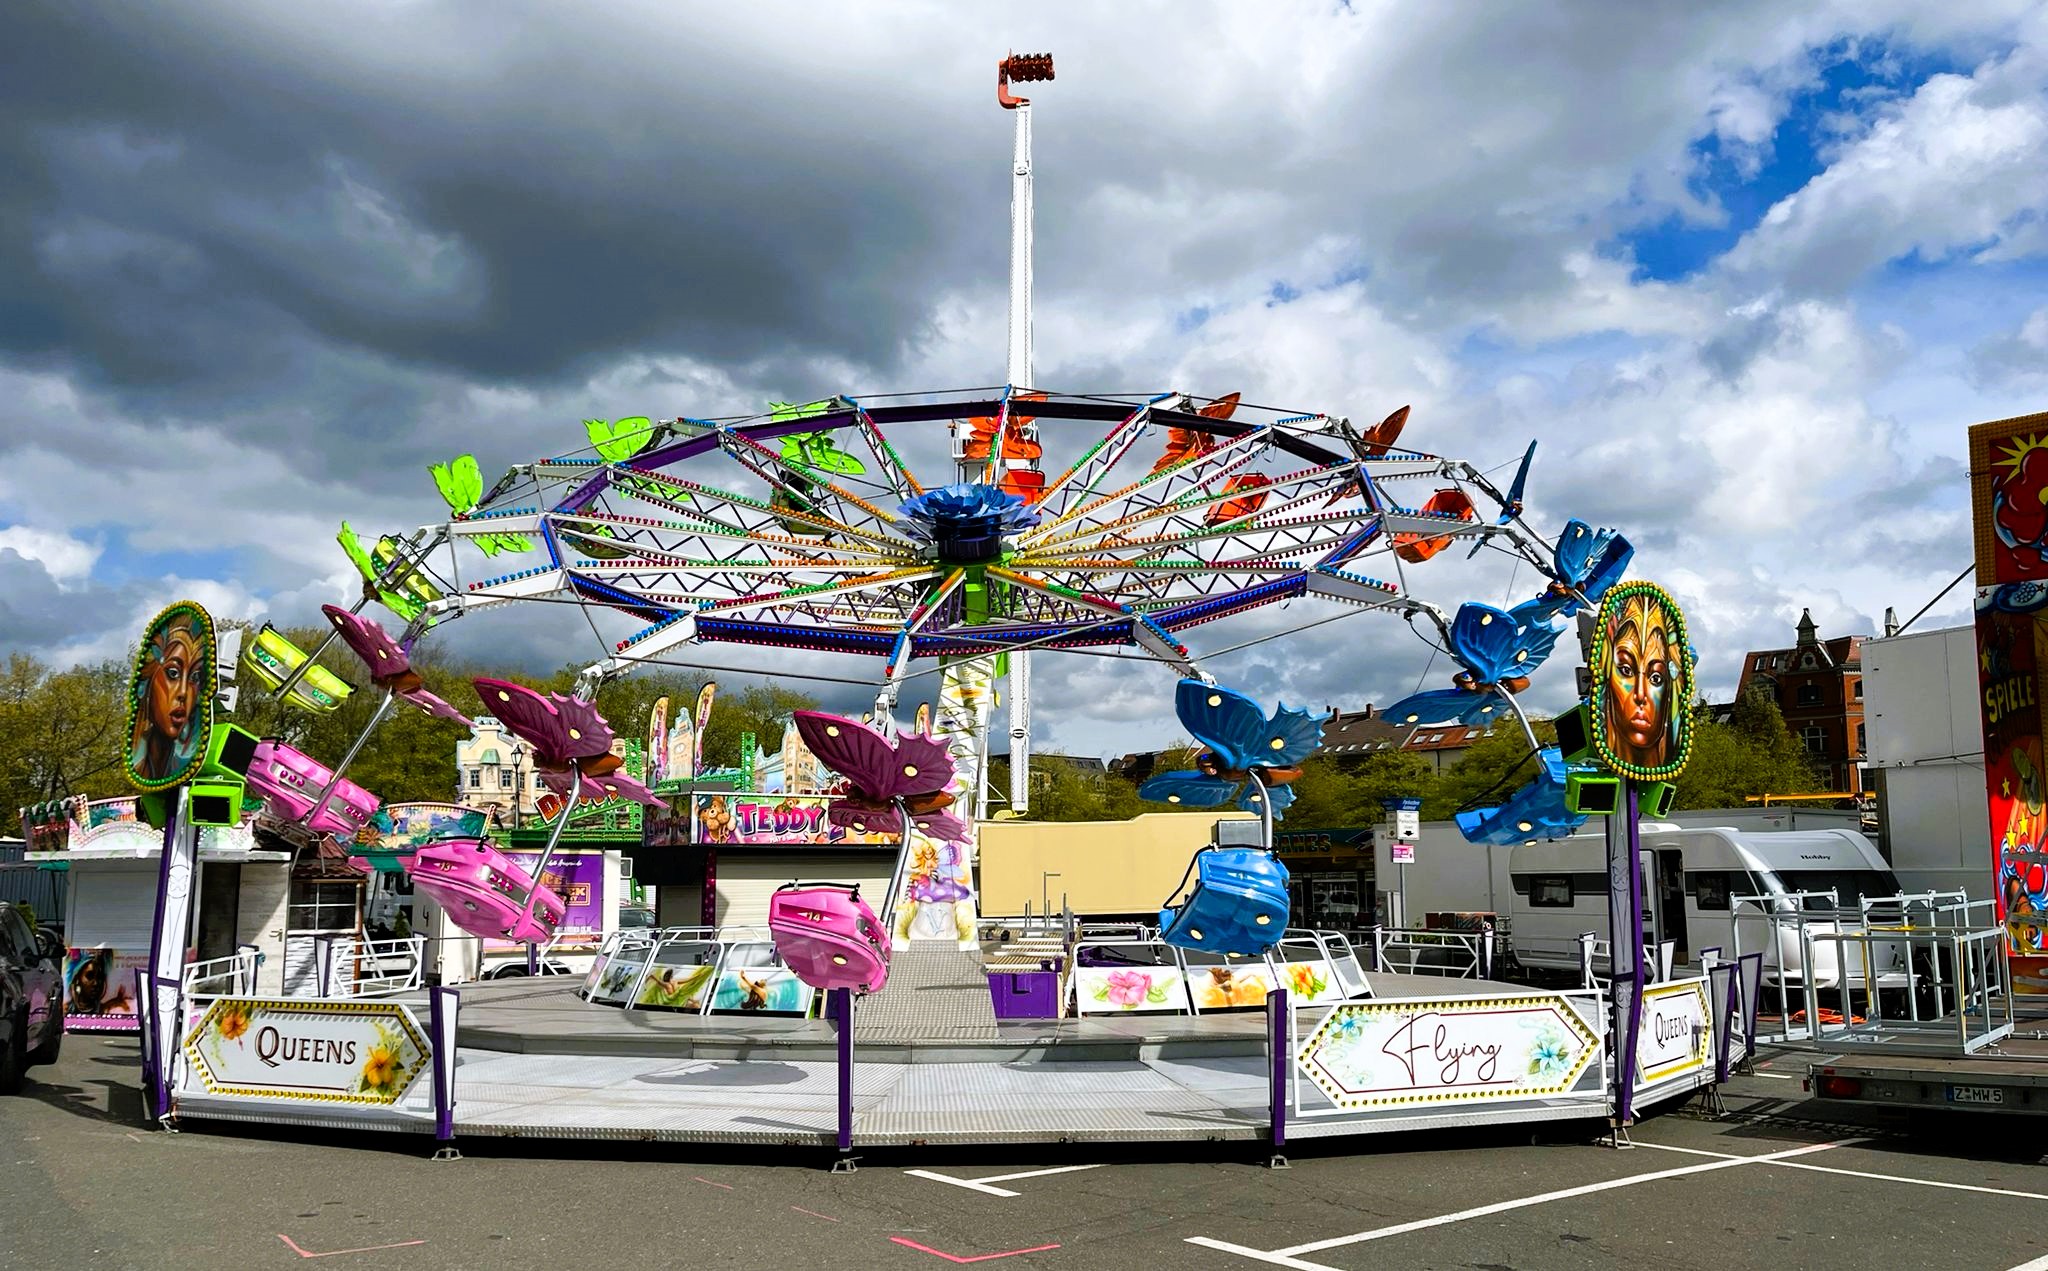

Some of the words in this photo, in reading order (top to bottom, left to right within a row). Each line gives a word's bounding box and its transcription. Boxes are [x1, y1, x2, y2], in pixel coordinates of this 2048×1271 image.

[1986, 675, 2035, 723] SPIELE
[736, 803, 826, 836] TEDDY
[807, 911, 821, 923] 14
[254, 1025, 357, 1068] QUEENS
[1382, 1012, 1502, 1086] Flying
[1655, 1012, 1688, 1050] QUEENS
[1955, 1087, 1964, 1100] Z
[1972, 1088, 1990, 1102] MW
[1993, 1089, 2002, 1102] 5
